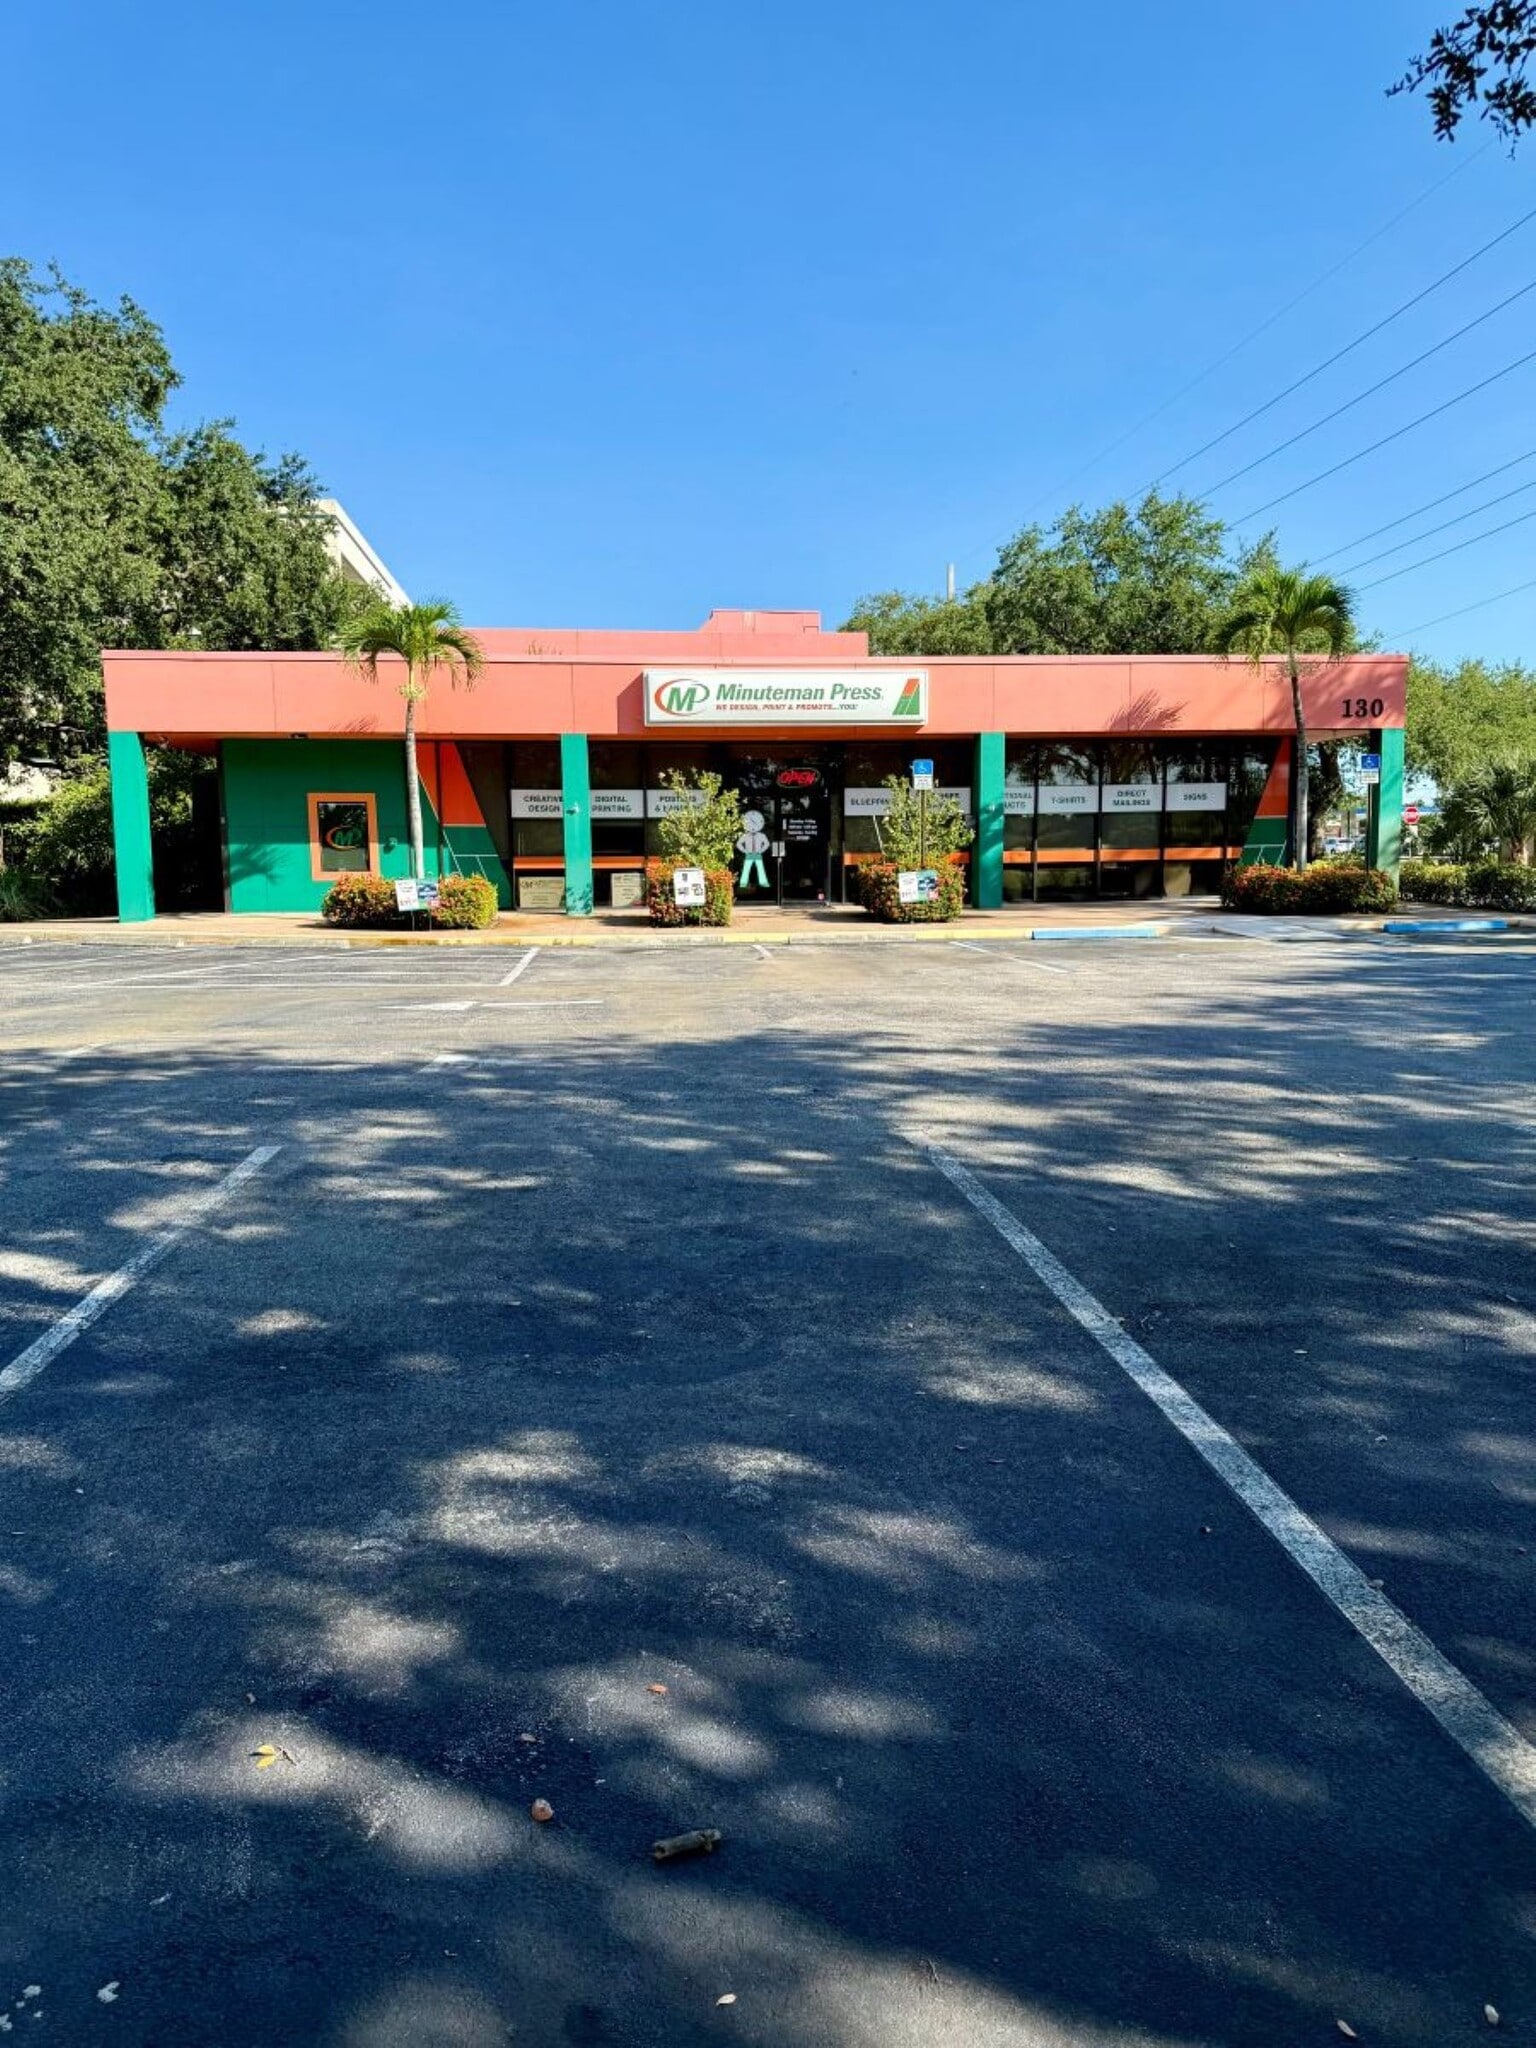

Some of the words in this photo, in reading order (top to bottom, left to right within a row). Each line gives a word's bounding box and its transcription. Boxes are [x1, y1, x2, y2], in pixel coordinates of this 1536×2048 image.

[716, 683, 825, 701] Minuteman
[830, 683, 882, 701] Press
[1342, 698, 1384, 718] 130
[779, 770, 816, 785] OPEN
[1117, 789, 1147, 797] DIRECT
[1183, 792, 1208, 801] SIGNS
[594, 795, 628, 803] DIGITAL
[1051, 796, 1086, 805] T-SHIRTS
[528, 804, 560, 813] DESIGN
[592, 804, 632, 813] PRINTING
